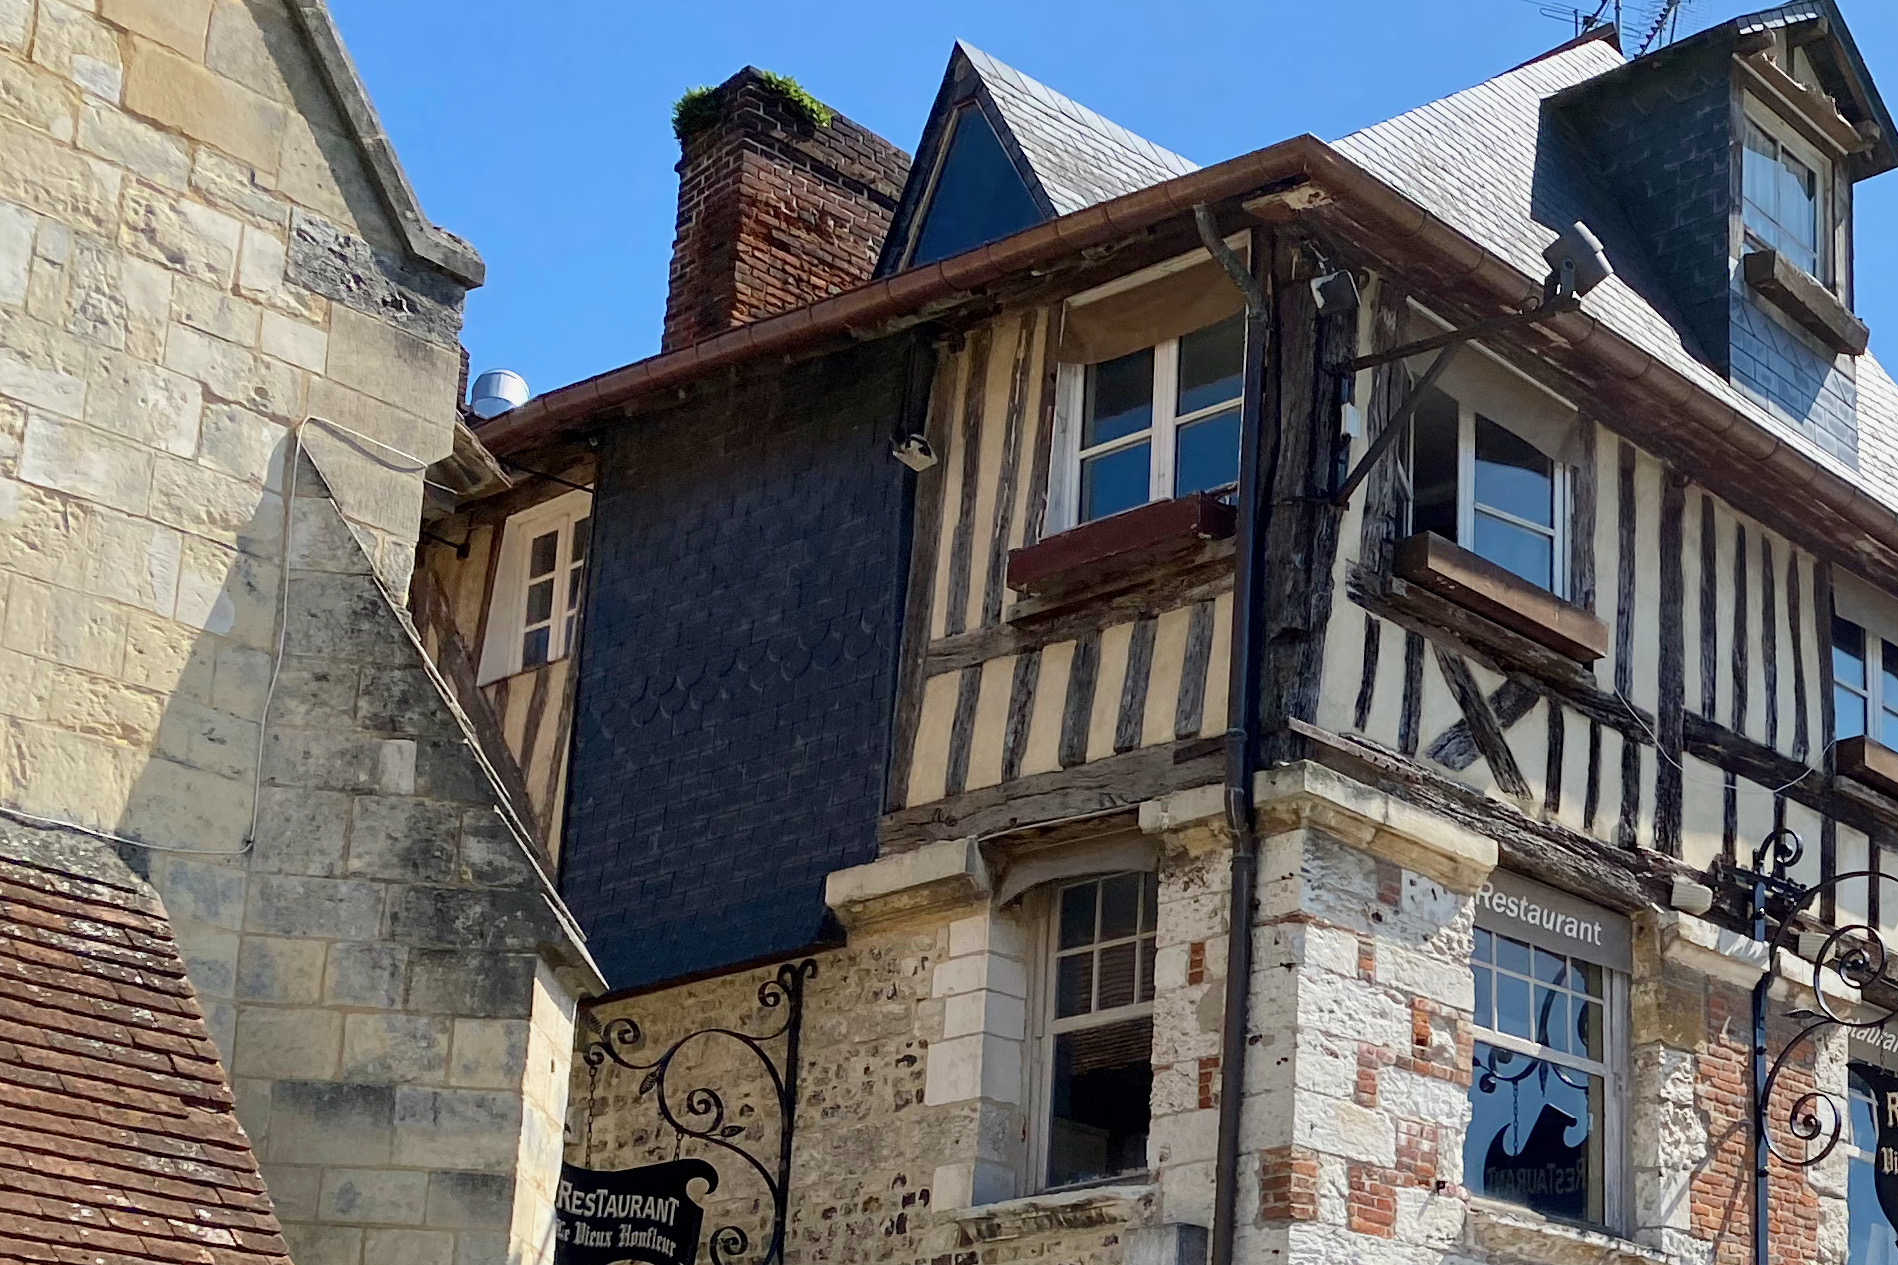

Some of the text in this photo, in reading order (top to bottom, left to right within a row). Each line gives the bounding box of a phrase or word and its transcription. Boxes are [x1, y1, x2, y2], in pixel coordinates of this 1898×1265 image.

[1475, 881, 1603, 946] Restaurant
[556, 1180, 680, 1227] RESTAURANT
[573, 1221, 613, 1248] Vieux
[618, 1223, 677, 1258] Honfleur
